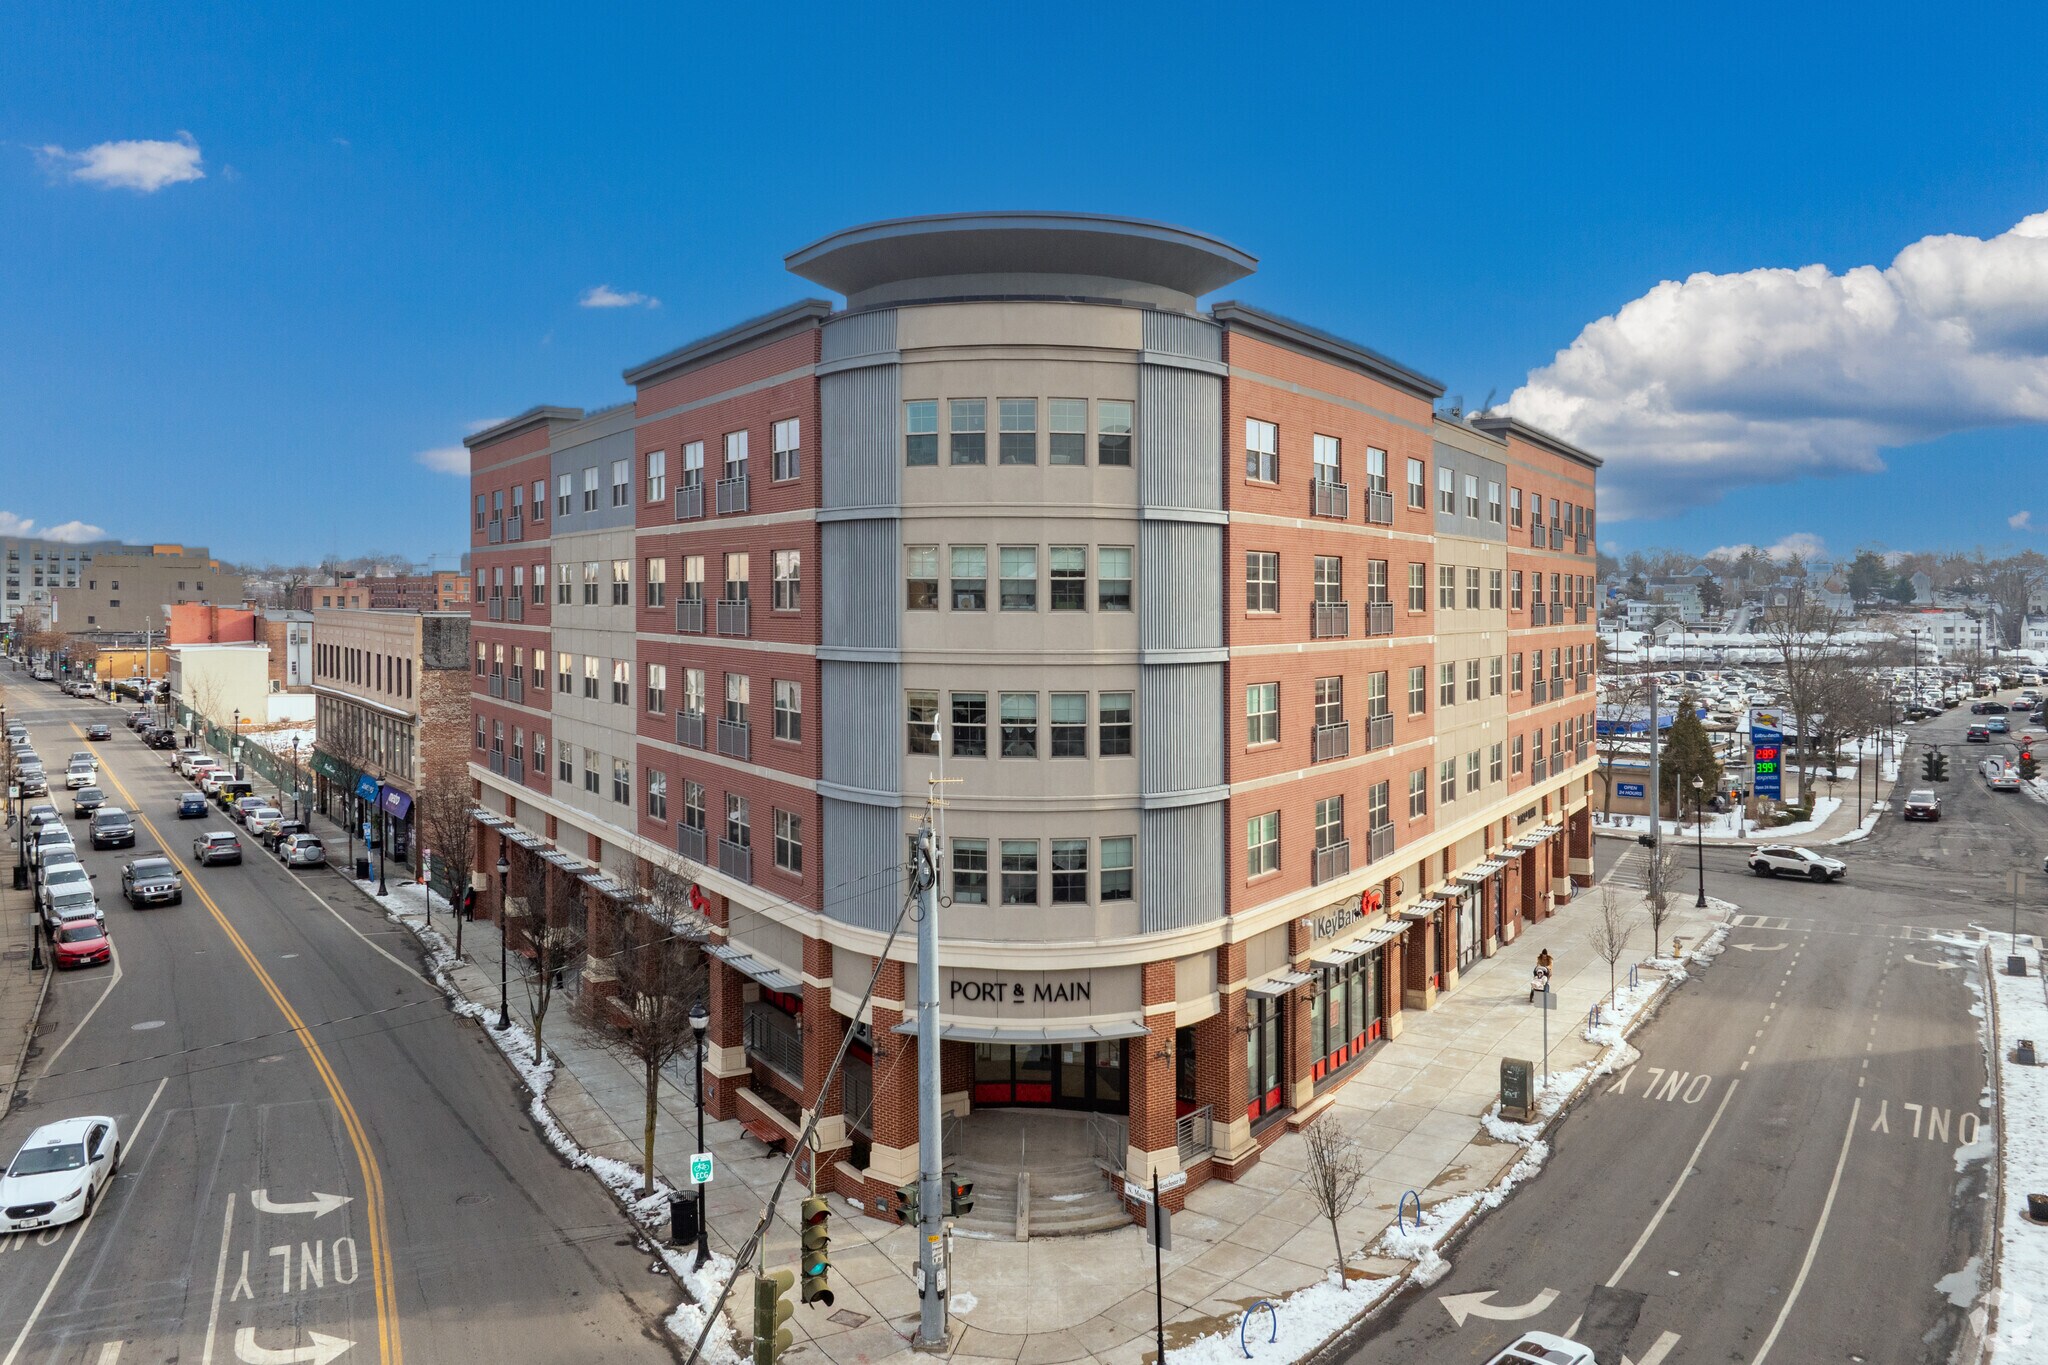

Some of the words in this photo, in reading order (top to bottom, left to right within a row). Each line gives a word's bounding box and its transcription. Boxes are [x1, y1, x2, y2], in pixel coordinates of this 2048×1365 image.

[950, 980, 1008, 1002] PORT
[1013, 983, 1024, 1003] &
[1033, 981, 1090, 1003] MAIN
[1607, 1064, 1712, 1104] ONLY
[1870, 1099, 1981, 1146] ONLY
[229, 1236, 359, 1302] ONLY
